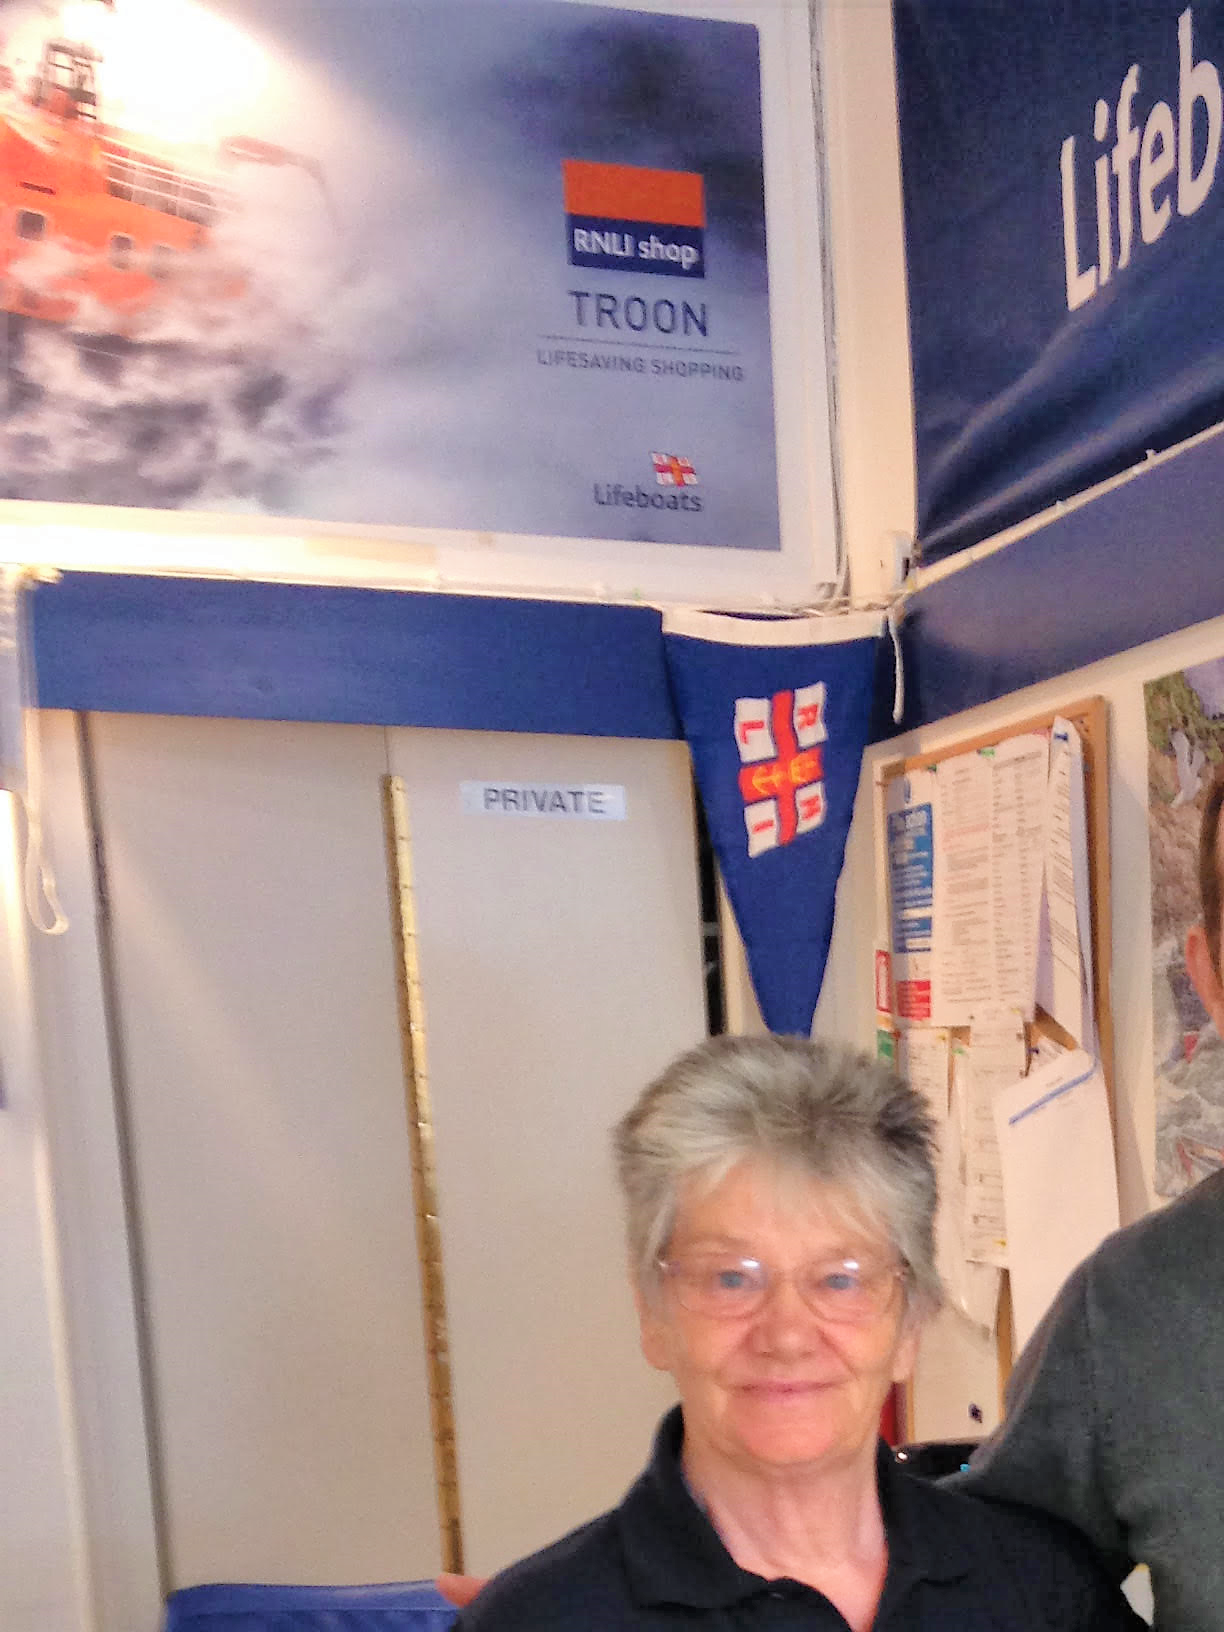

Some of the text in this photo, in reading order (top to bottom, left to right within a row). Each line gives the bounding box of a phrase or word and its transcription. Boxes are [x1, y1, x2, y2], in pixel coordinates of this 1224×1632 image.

[573, 227, 700, 270] RNLI shop
[567, 290, 708, 337] TROON
[537, 350, 745, 381] LIFESAVING SHOPPING
[593, 483, 703, 512] Lifeboats
[484, 788, 606, 814] PRIVATE
